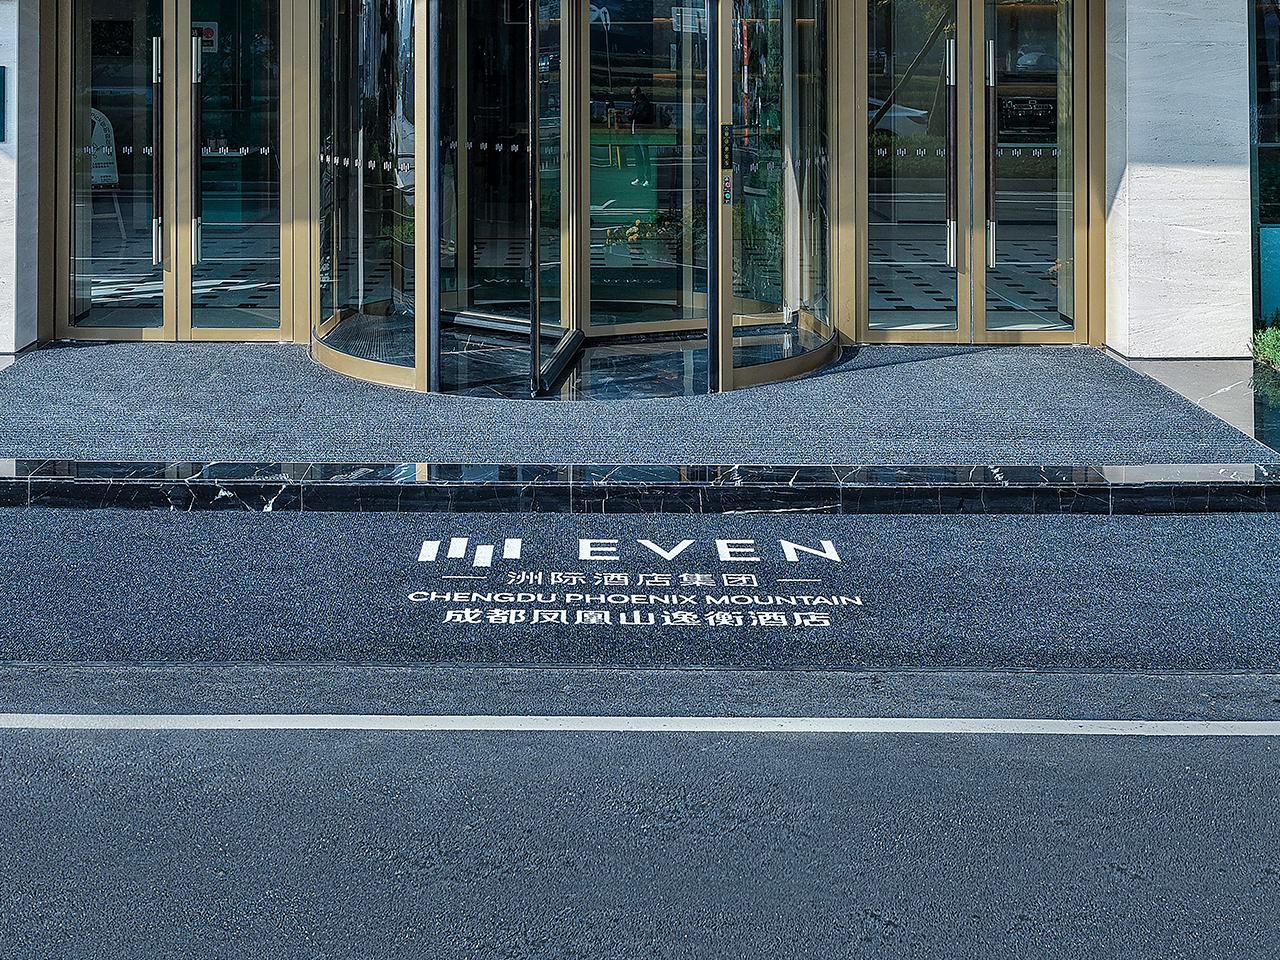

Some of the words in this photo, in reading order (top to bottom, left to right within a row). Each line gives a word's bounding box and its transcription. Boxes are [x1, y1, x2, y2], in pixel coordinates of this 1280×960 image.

[577, 538, 842, 563] EVEN
[506, 571, 759, 589] 洲际酒店集团
[407, 591, 558, 604] CHENGDU
[566, 592, 697, 605] PHOENIX
[705, 592, 863, 606] MOUNTAIN
[442, 608, 833, 628] 成都凤凰山逸衡酒店
